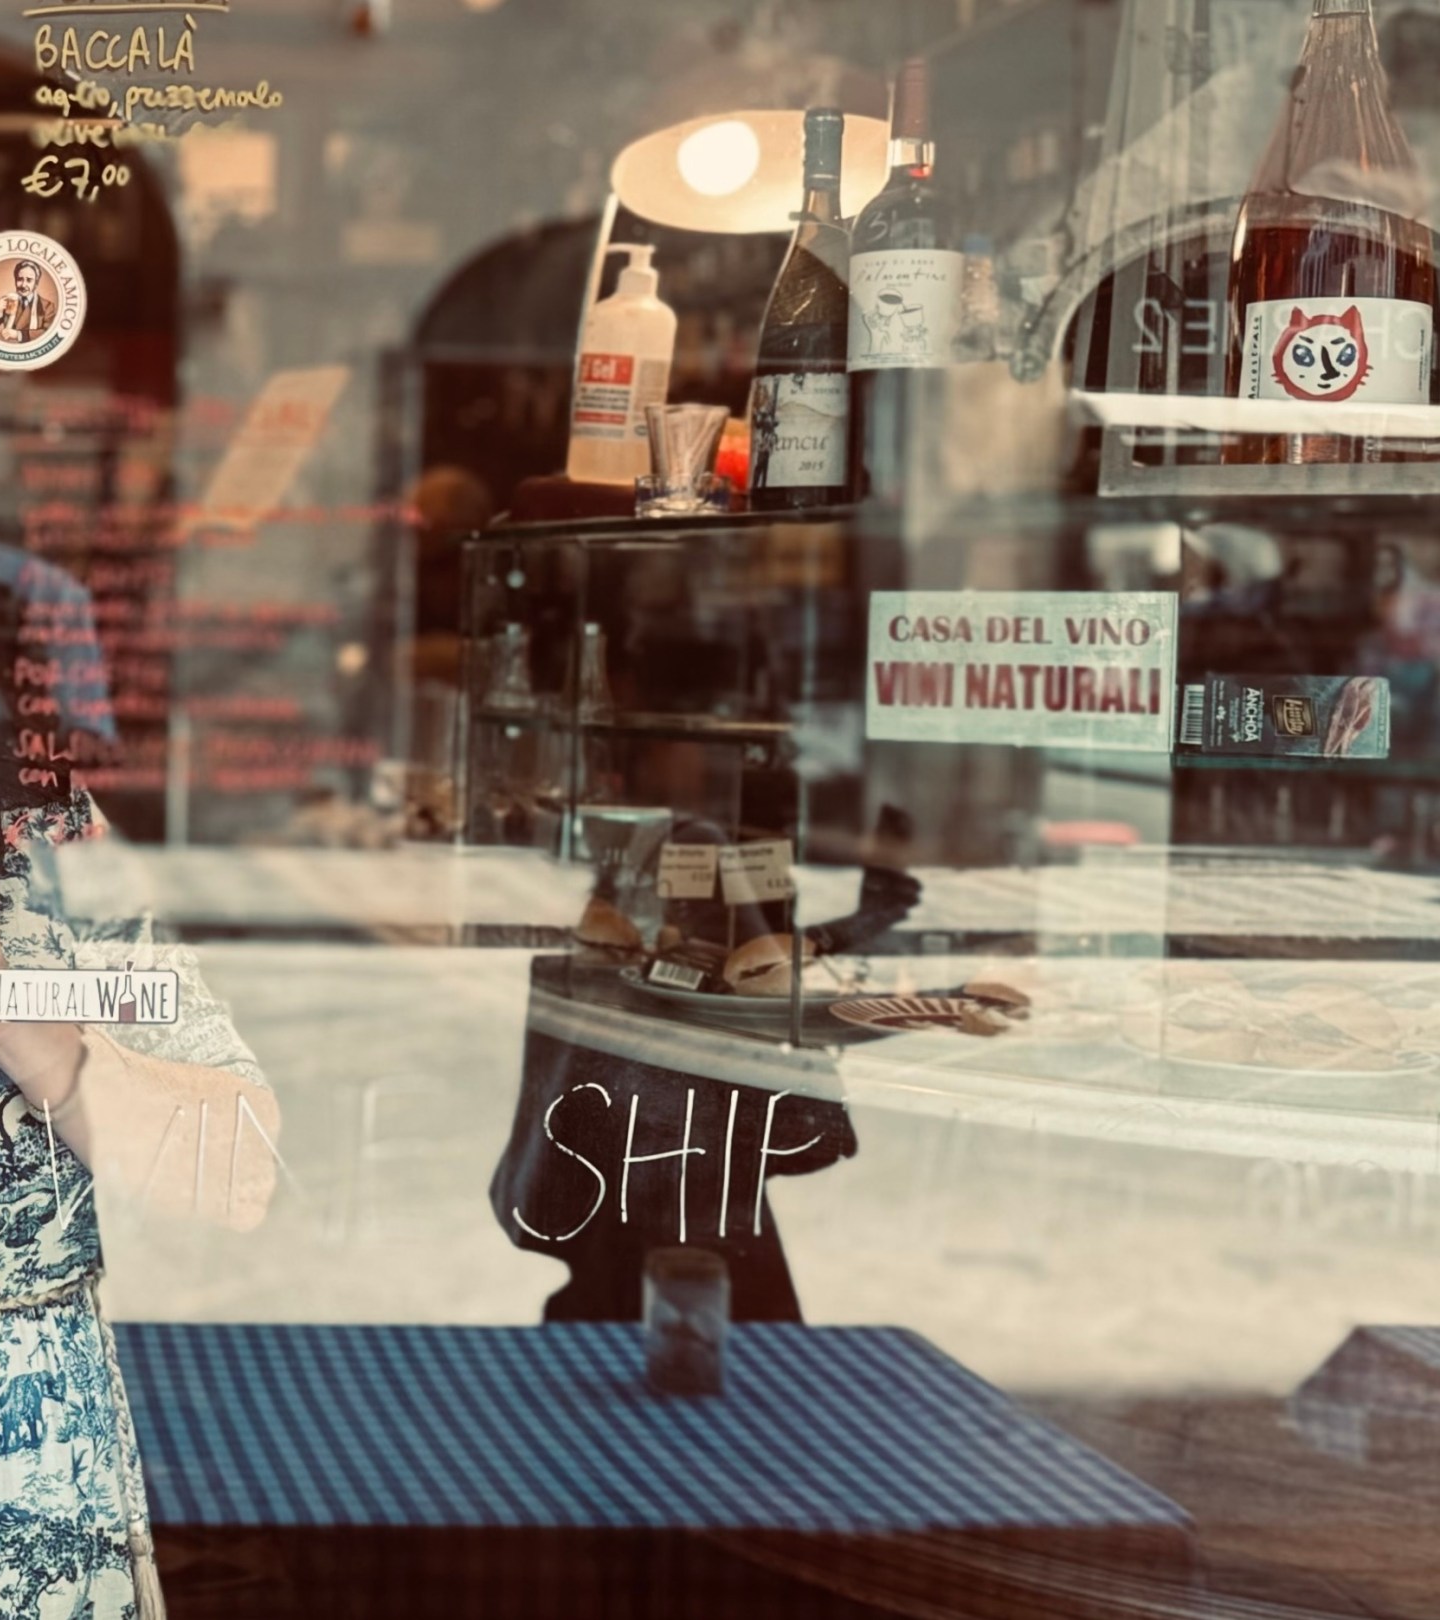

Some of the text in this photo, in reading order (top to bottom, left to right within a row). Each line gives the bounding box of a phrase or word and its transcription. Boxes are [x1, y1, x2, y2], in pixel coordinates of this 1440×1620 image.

[34, 13, 198, 73] BACCALÀ
[7, 239, 68, 275] LOCALE
[60, 276, 78, 332] AMICO
[888, 614, 1151, 646] CASA DEL VINO
[873, 661, 955, 708] VINI
[964, 662, 1162, 715] NATURALI
[1245, 687, 1259, 743] ANCHOA
